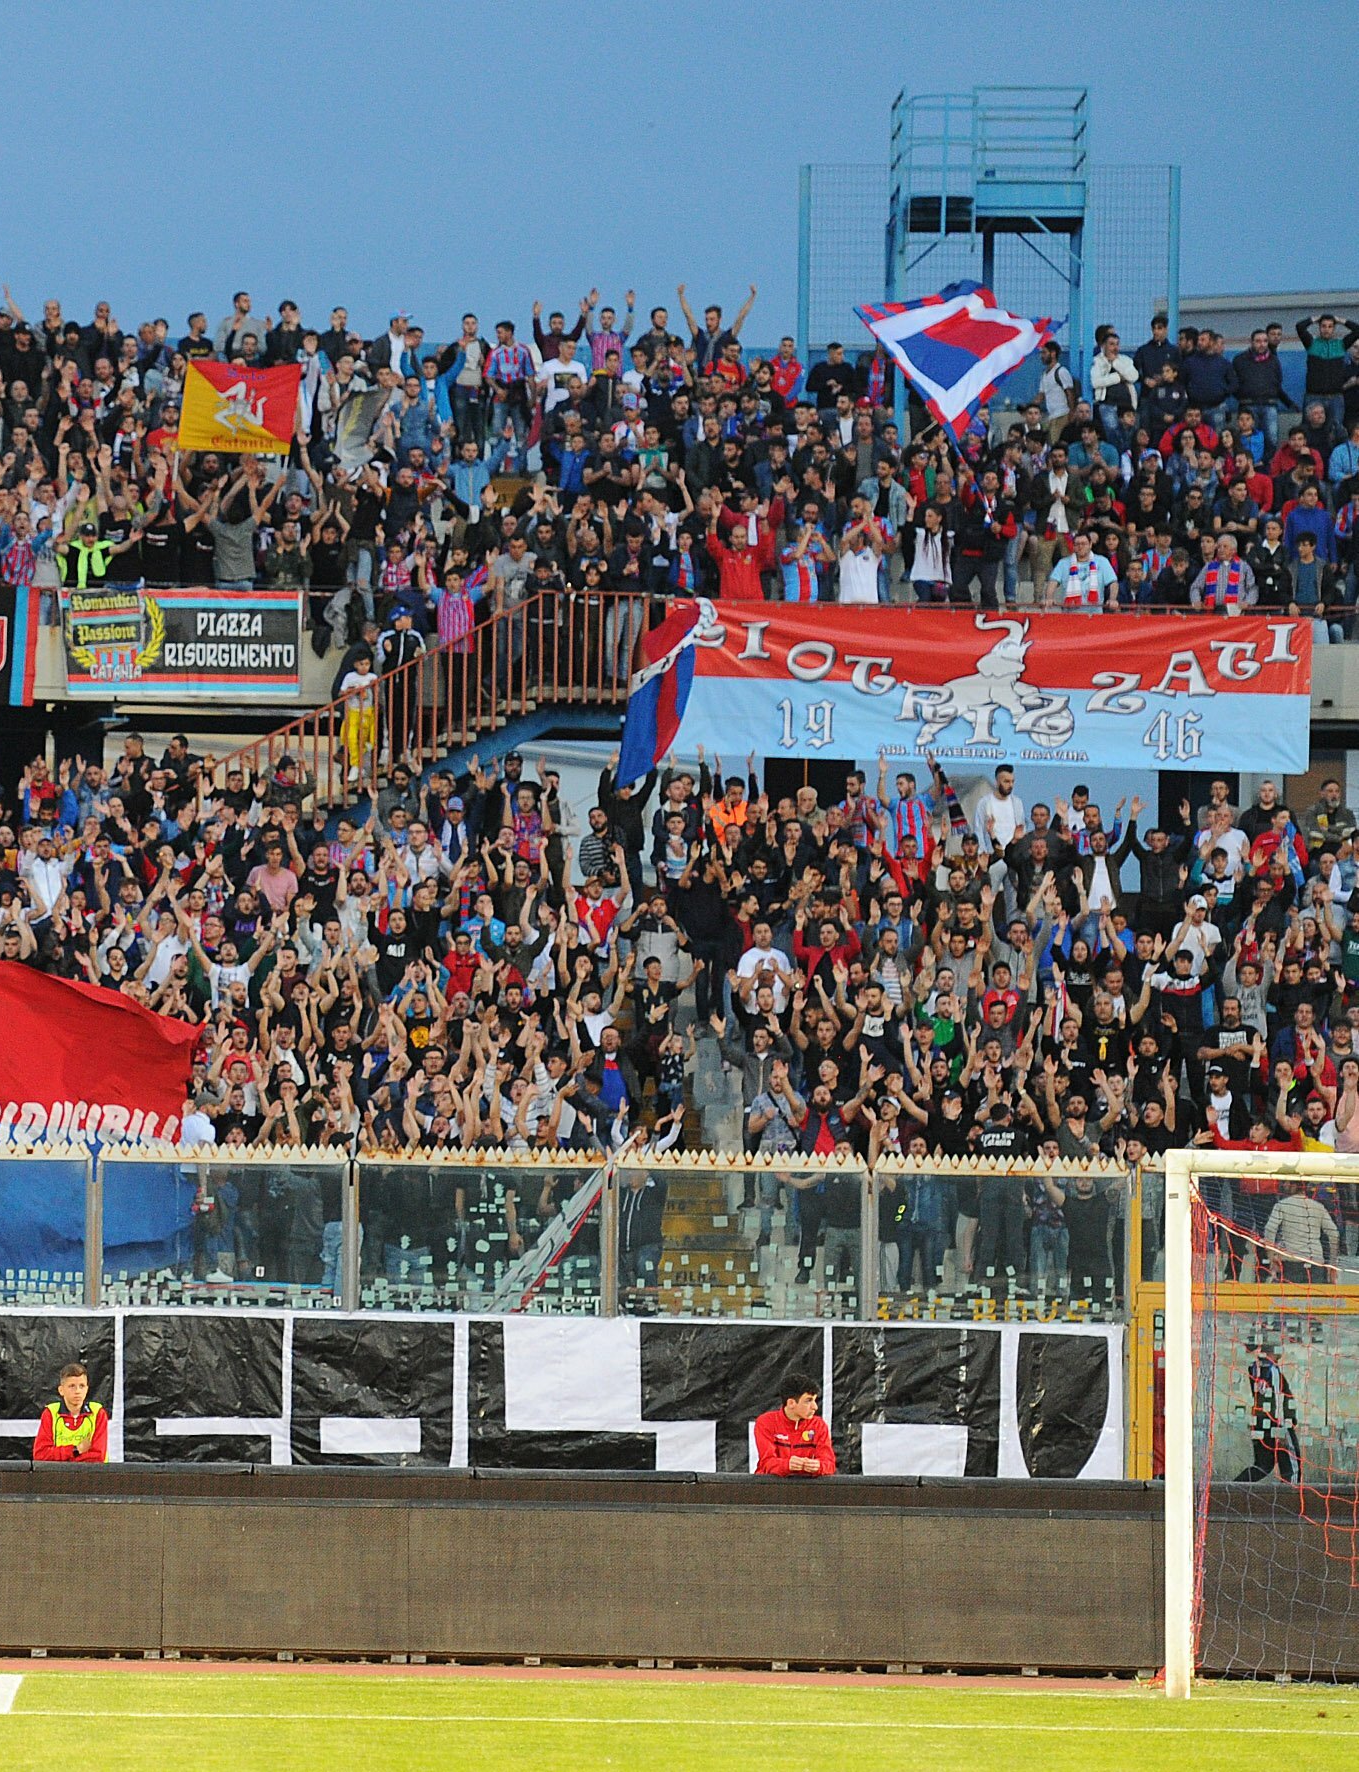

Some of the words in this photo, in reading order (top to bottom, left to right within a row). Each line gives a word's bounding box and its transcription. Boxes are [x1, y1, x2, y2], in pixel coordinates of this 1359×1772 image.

[211, 437, 274, 449] Catania
[72, 593, 139, 612] Romantica
[77, 623, 137, 645] Passione
[196, 611, 263, 638] PIAZZA
[164, 640, 296, 669] RISORGIMENTO
[89, 663, 143, 681] CATANIA
[776, 696, 836, 750] 19
[1141, 709, 1203, 762] 46
